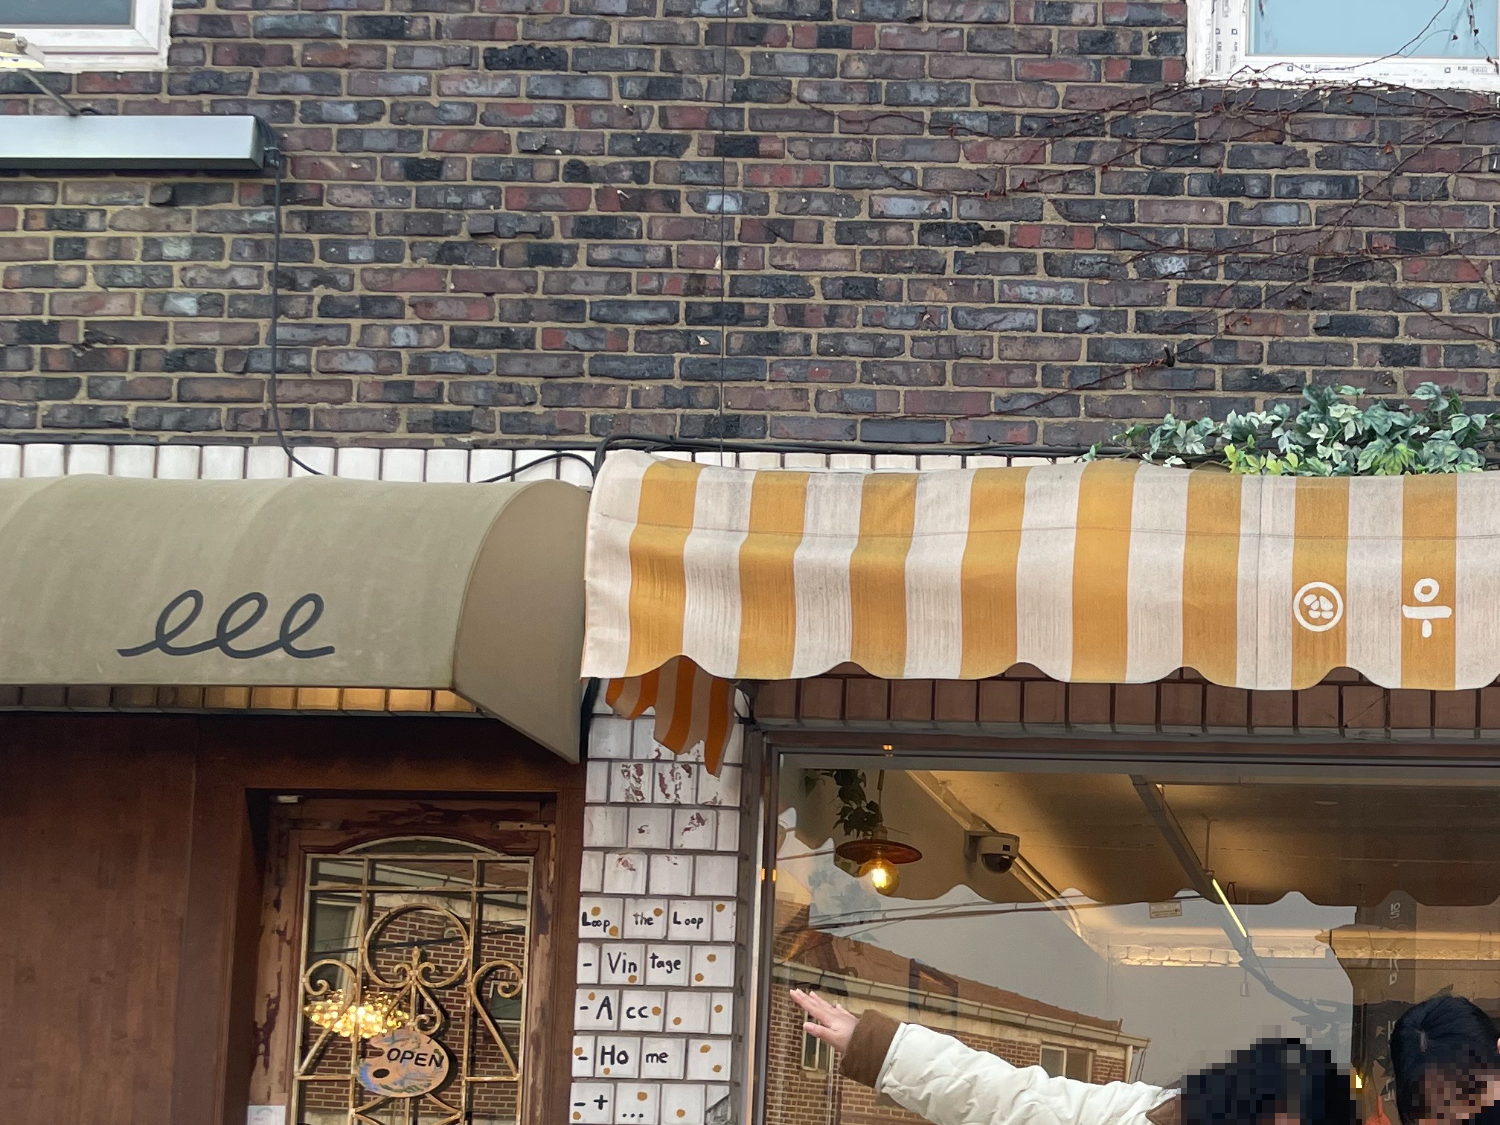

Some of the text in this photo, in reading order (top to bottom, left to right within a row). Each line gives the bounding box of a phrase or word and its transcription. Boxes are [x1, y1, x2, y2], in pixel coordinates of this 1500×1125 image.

[581, 911, 704, 933] Loop the Loop
[606, 951, 681, 975] Vintage
[595, 996, 648, 1021] Acc
[387, 1048, 444, 1068] OPEN
[600, 1044, 670, 1066] Home
